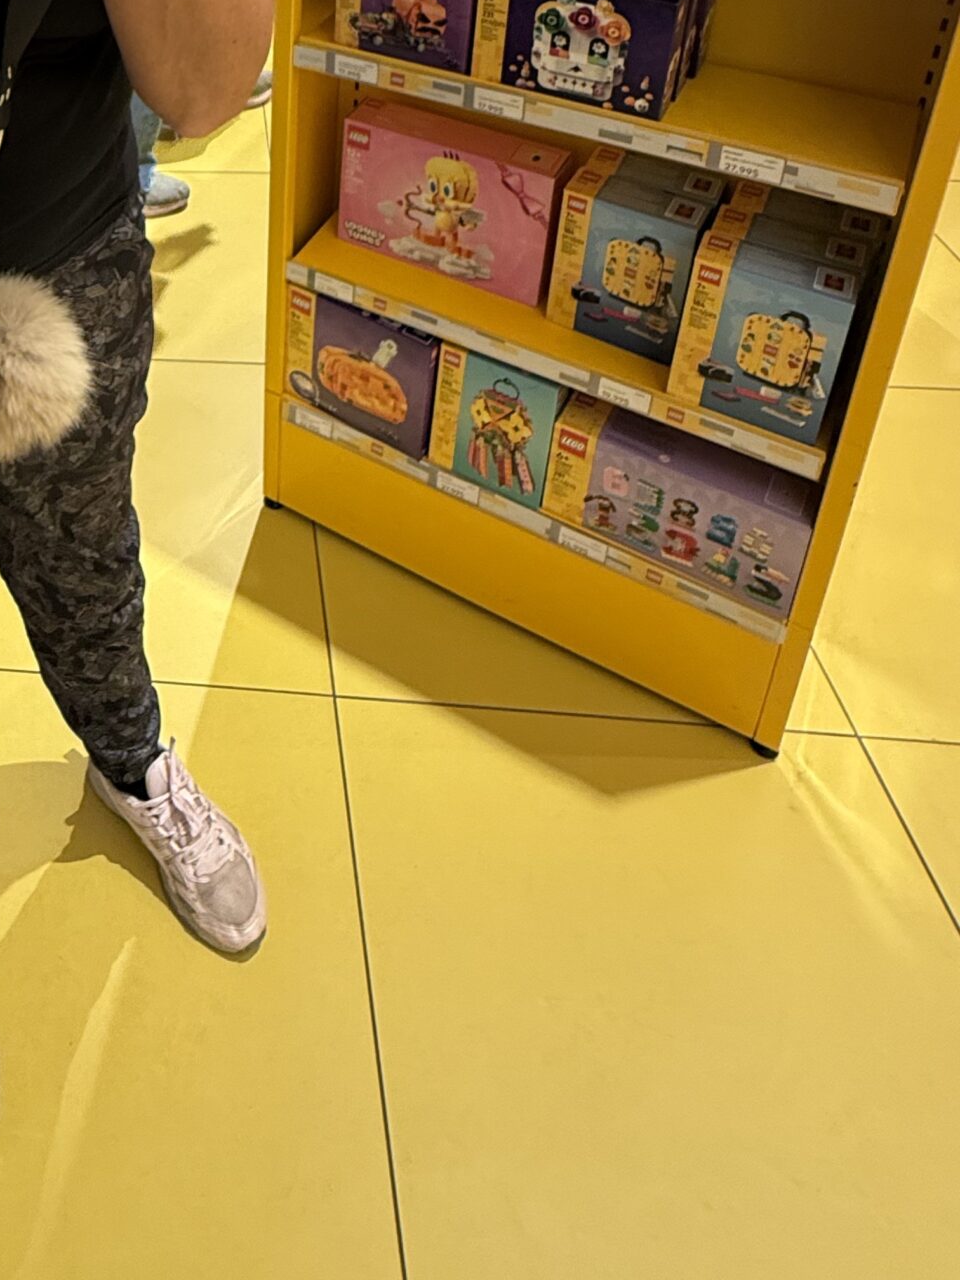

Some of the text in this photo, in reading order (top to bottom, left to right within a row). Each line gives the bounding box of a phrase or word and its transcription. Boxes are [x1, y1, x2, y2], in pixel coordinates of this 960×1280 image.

[699, 269, 721, 282] LEGO
[291, 296, 311, 310] LEGO
[559, 435, 586, 451] LEGO
